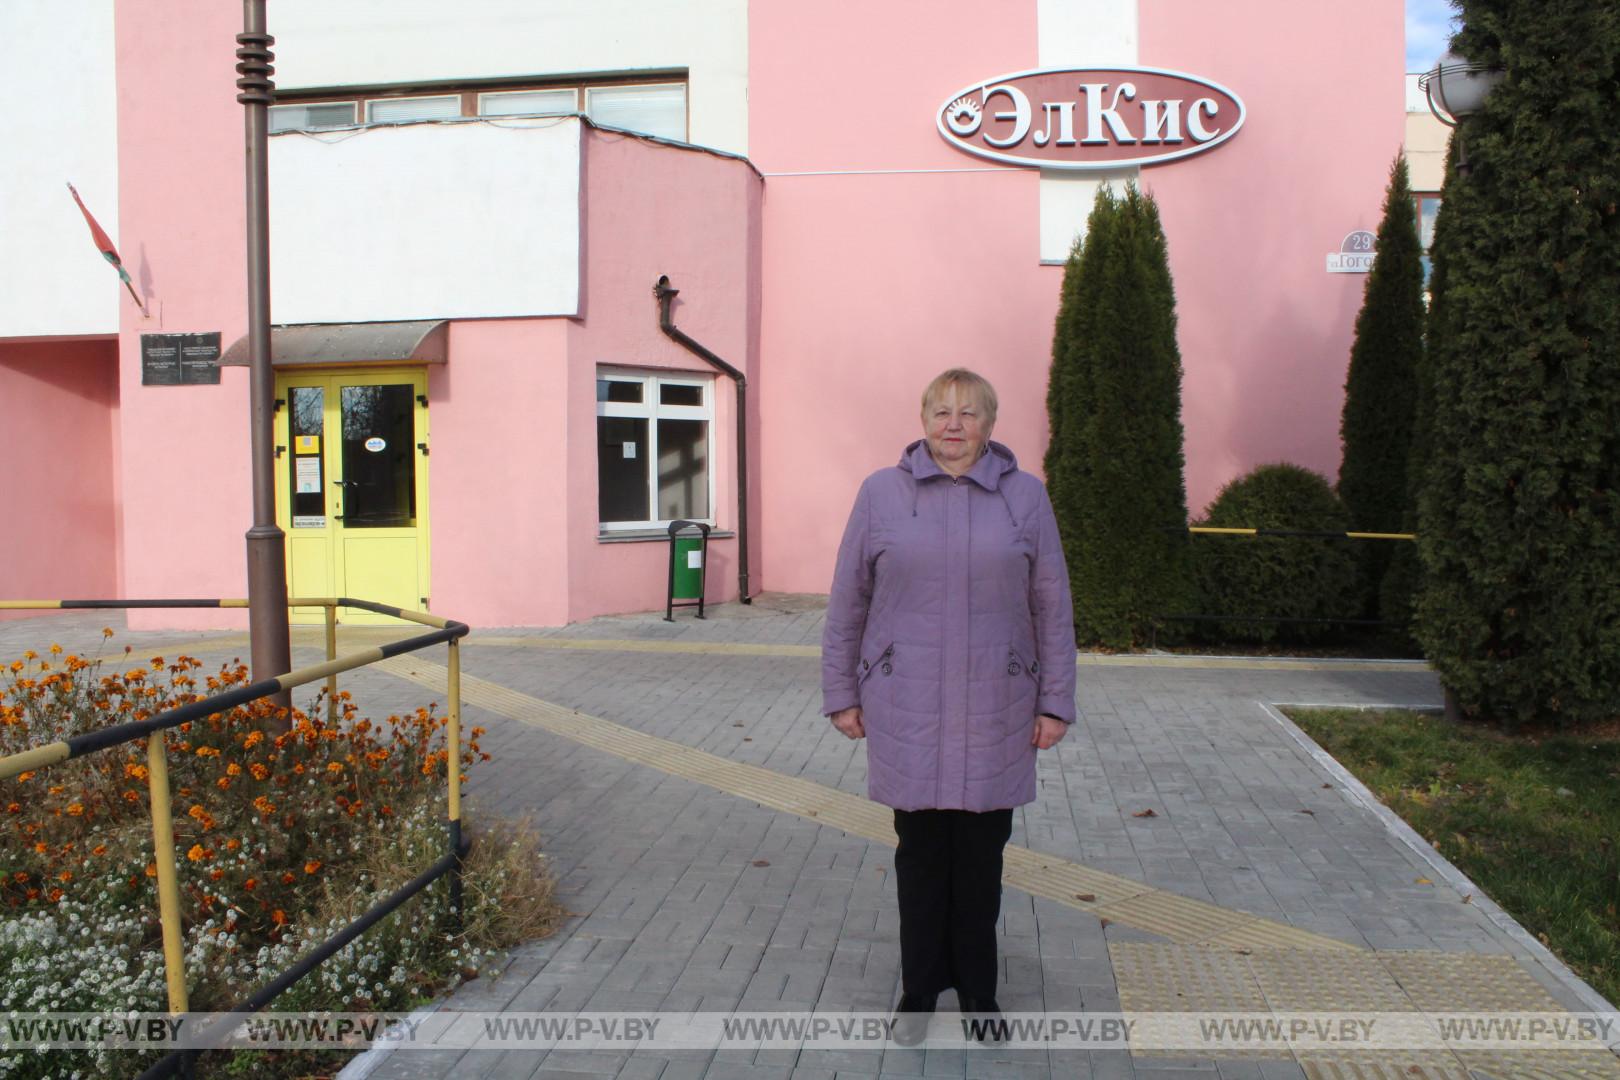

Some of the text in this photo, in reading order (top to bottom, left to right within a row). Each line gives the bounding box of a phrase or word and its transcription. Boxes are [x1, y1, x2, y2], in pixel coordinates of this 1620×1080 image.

[983, 83, 1221, 147] ЭлКис
[1352, 235, 1371, 250] 29
[1340, 254, 1376, 268] Гого
